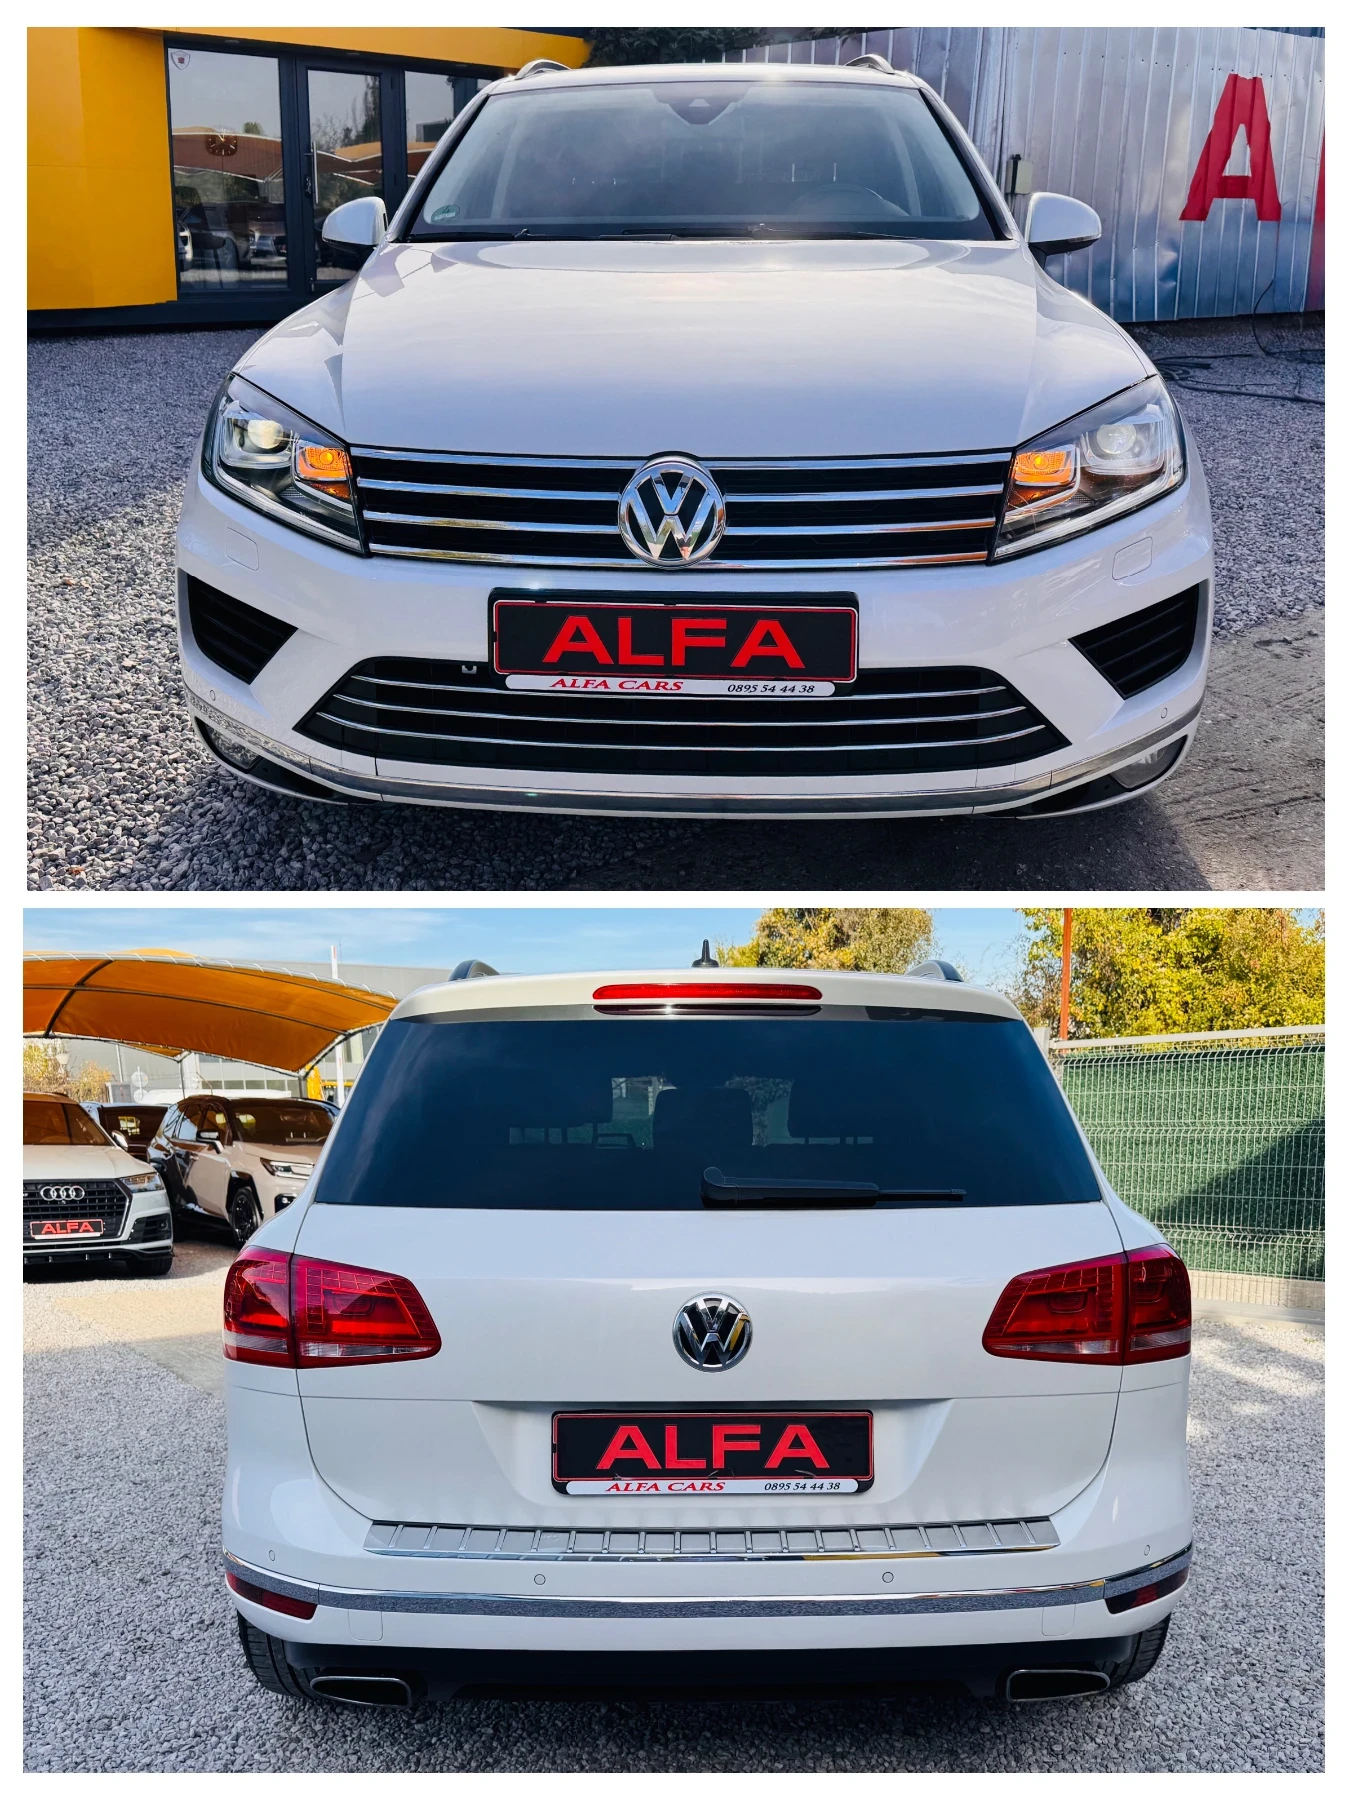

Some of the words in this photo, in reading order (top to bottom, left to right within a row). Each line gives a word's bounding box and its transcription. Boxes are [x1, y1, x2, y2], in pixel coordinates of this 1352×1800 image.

[622, 460, 722, 565] VW
[542, 615, 806, 669] ALFA
[549, 678, 611, 690] ALFA
[618, 680, 684, 691] CARS
[727, 684, 758, 694] 0895
[760, 684, 776, 693] 54
[780, 685, 796, 693] 44
[798, 685, 815, 693] 38
[41, 1221, 94, 1234] ALFA
[674, 1293, 751, 1371] VW
[595, 1424, 830, 1470] ALFA
[605, 1482, 661, 1492] ALFA
[667, 1482, 726, 1492] CARS
[764, 1482, 791, 1491] 0895
[793, 1482, 808, 1491] 54
[810, 1482, 824, 1491] 44
[826, 1482, 841, 1491] 38
